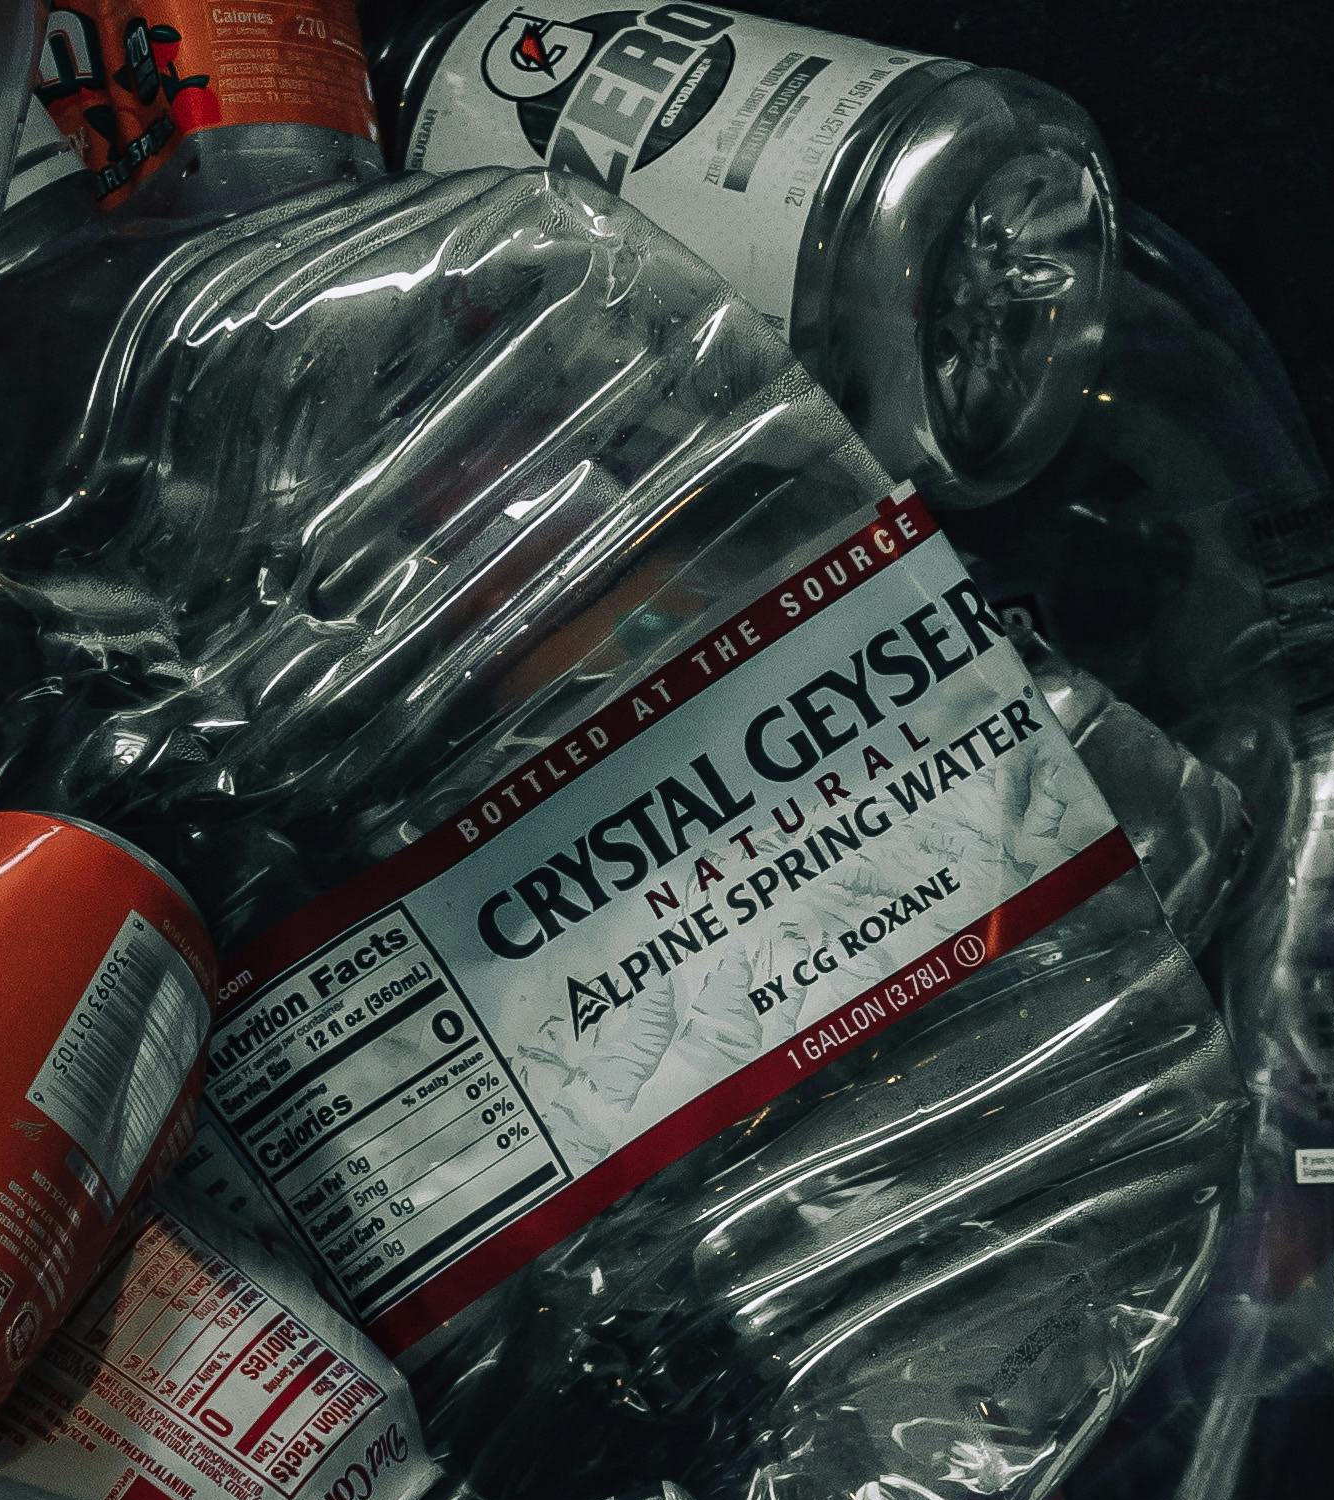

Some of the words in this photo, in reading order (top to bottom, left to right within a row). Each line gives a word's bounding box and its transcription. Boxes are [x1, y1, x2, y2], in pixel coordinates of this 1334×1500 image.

[212, 8, 274, 26] Calories
[295, 14, 327, 40] 270
[547, 3, 736, 196] ZERO
[456, 725, 611, 844] BOTTLED
[630, 681, 674, 723] AT
[690, 621, 763, 679] THE
[778, 509, 921, 616] SOURCE
[477, 765, 757, 960] CRYSTAL
[745, 576, 1010, 783] GEYSER
[642, 722, 932, 918] NATURAL
[564, 902, 730, 1041] ALPINE
[726, 783, 894, 922] SPRING
[885, 695, 1045, 822] WATER
[309, 928, 408, 998] Facts
[749, 976, 789, 1017] BY
[792, 945, 840, 991] CG
[840, 867, 963, 960] ROXANE
[305, 1034, 329, 1053] 12
[347, 1008, 366, 1027] oz
[366, 961, 434, 1016] (360mL)
[804, 993, 886, 1064] GALLON
[884, 957, 952, 1015] (3.78L)
[257, 1094, 354, 1168] Calories
[432, 1010, 464, 1044] 0
[418, 1077, 449, 1101] Daily
[448, 1050, 485, 1078] Value
[347, 1155, 371, 1178] 0g
[466, 1073, 500, 1101] 0%
[353, 1178, 389, 1207] 5mg
[390, 1195, 415, 1218] 0g
[382, 1235, 406, 1260] 0g
[241, 1318, 309, 1382] Calories
[72, 1406, 129, 1454] CONTAINS
[199, 1408, 234, 1440] 0
[316, 1377, 377, 1434] Nutrition
[271, 1431, 324, 1483] Facts
[367, 1422, 409, 1471] Diet
